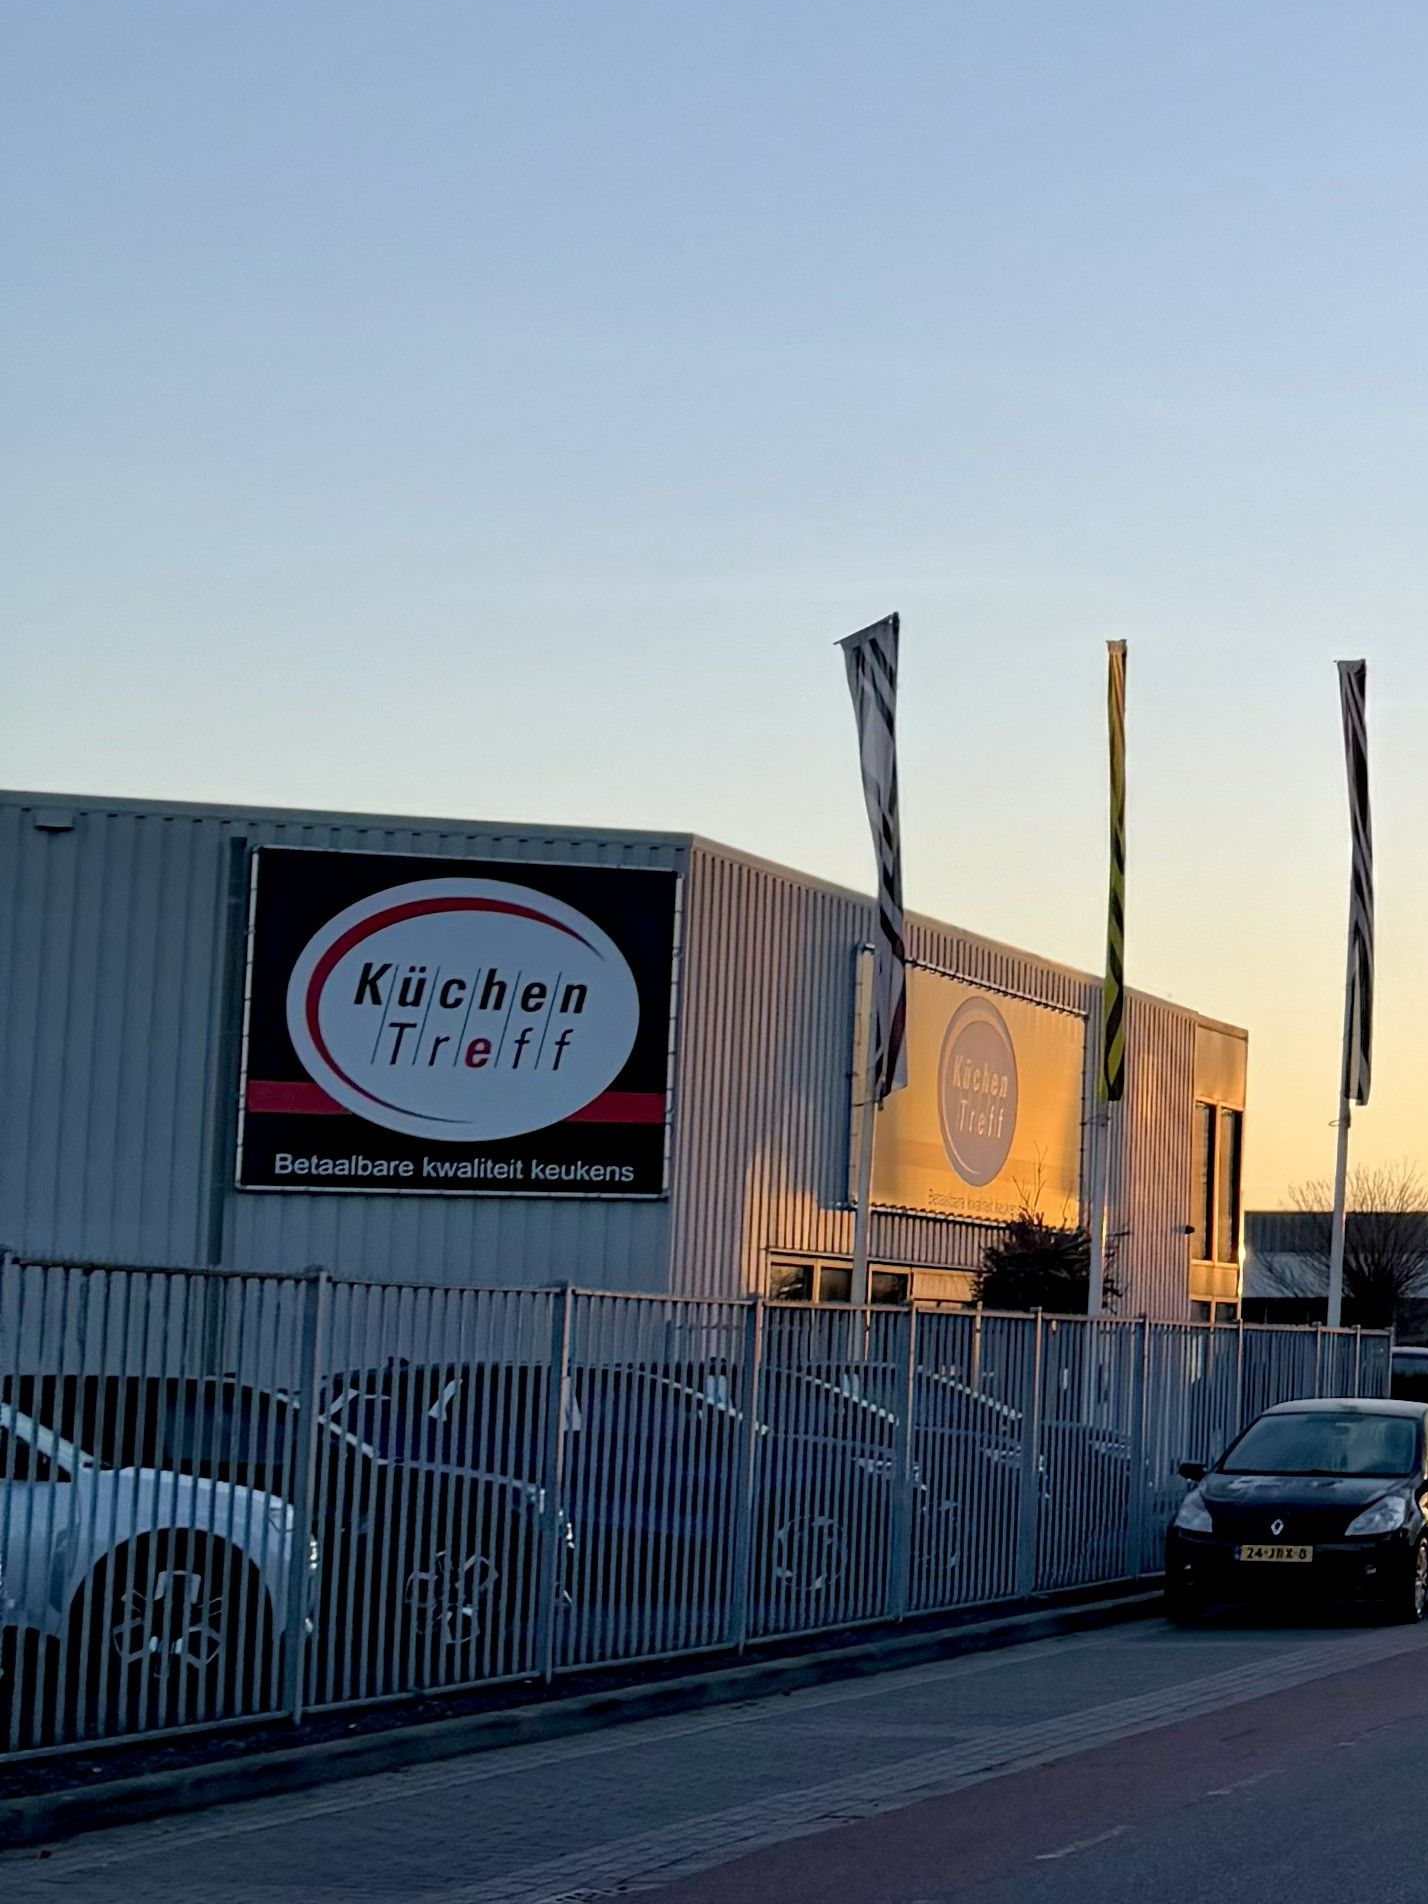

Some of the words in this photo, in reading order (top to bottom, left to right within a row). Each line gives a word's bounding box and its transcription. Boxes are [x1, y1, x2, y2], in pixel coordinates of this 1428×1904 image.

[352, 961, 588, 1014] Küchen
[388, 1022, 575, 1071] Treff
[952, 1055, 1008, 1098] Küchen
[959, 1099, 1004, 1138] Treff
[273, 1152, 415, 1178] Betaalbare
[421, 1156, 525, 1180] kwaliteit
[530, 1159, 636, 1182] keukens
